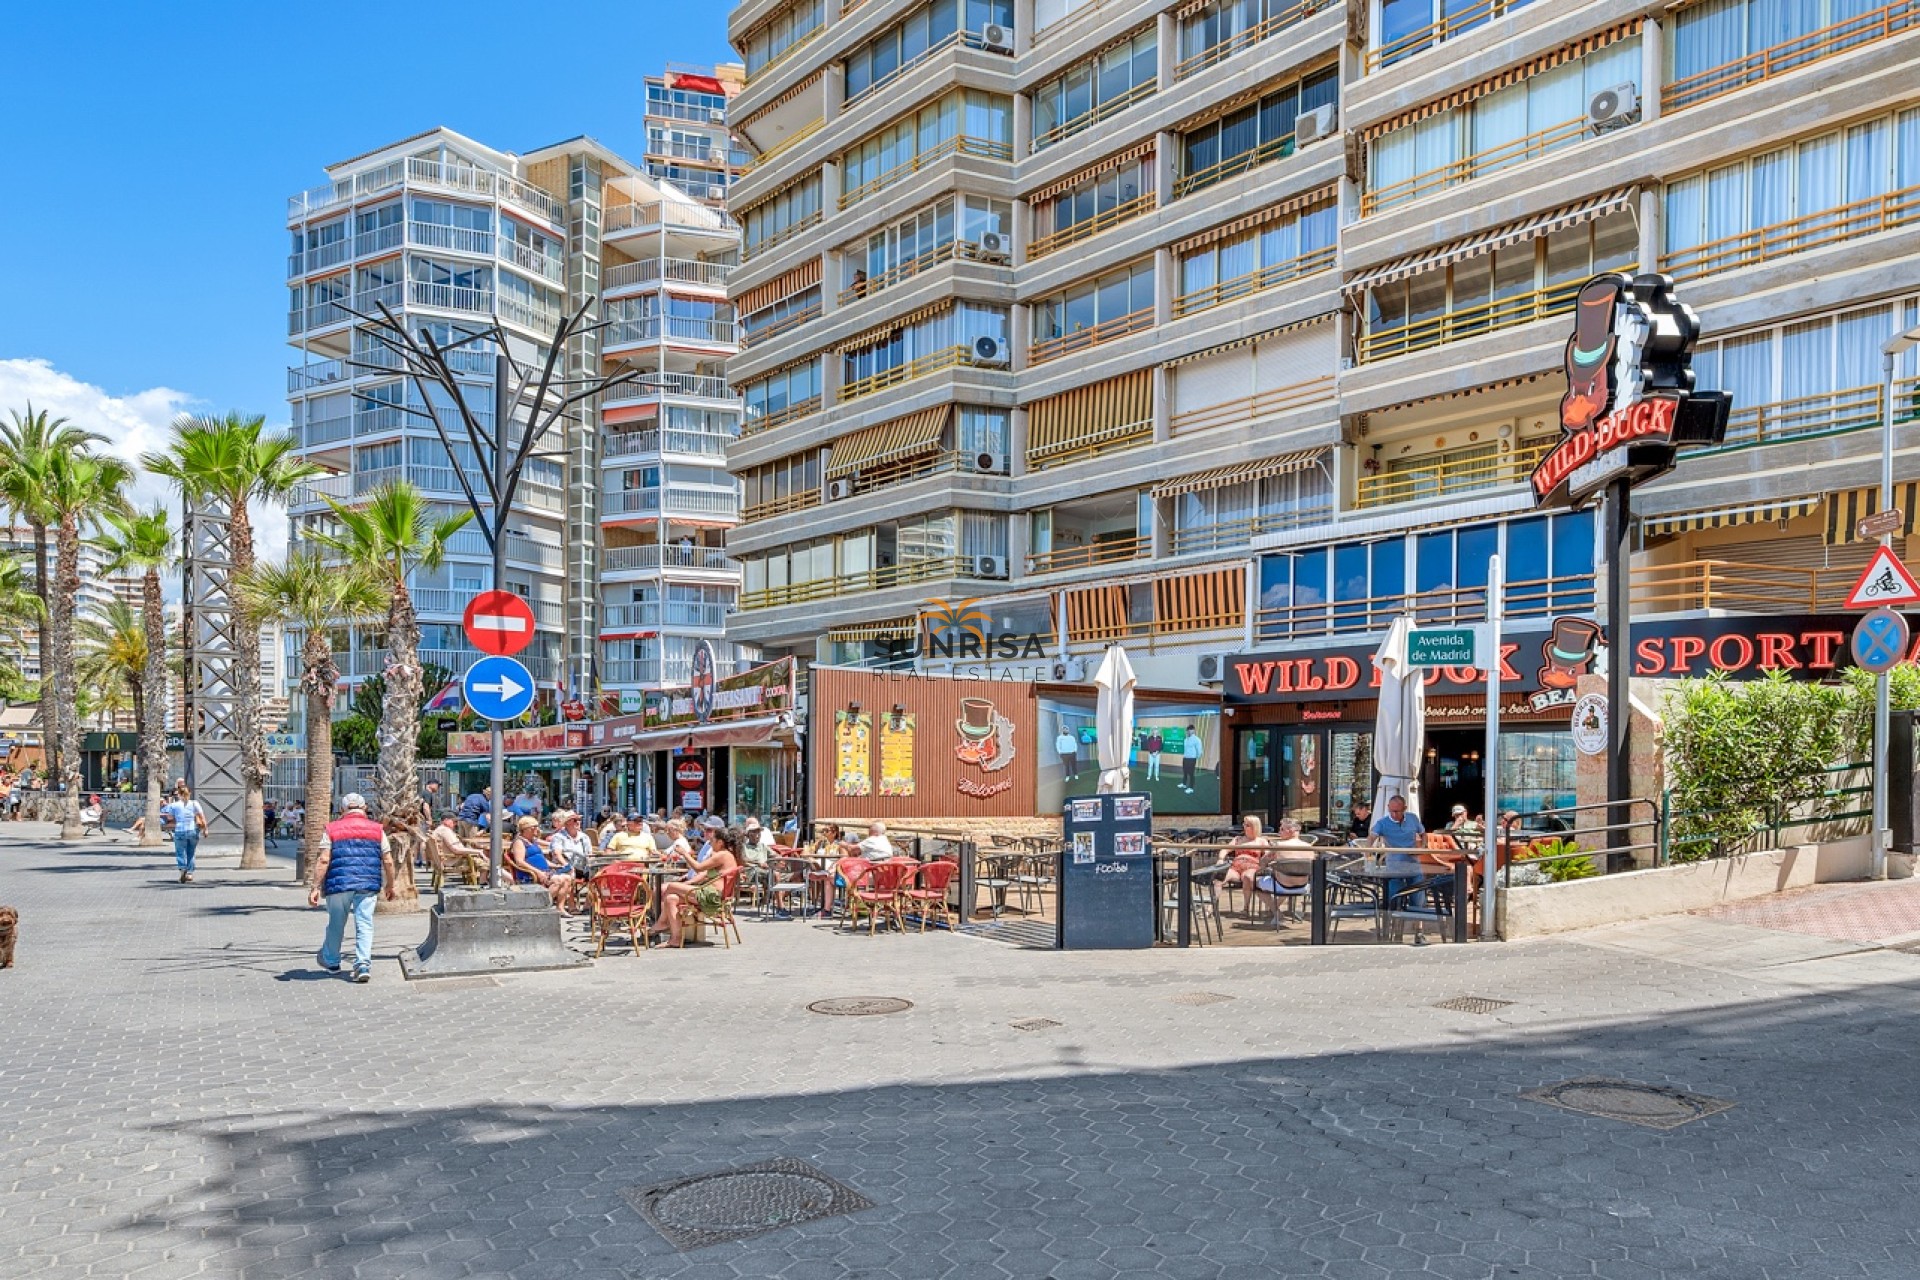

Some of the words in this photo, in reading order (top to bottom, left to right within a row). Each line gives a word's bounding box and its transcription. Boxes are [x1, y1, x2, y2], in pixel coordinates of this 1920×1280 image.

[1534, 432, 1590, 494] WILD
[1596, 398, 1676, 450] DUCK
[1417, 635, 1465, 647] Avenida
[1234, 656, 1362, 695] WILD
[1635, 631, 1844, 675] SPORT
[1411, 650, 1428, 662] de
[1429, 649, 1471, 661] Madrid
[1531, 688, 1577, 711] BEA
[1447, 705, 1470, 718] pub
